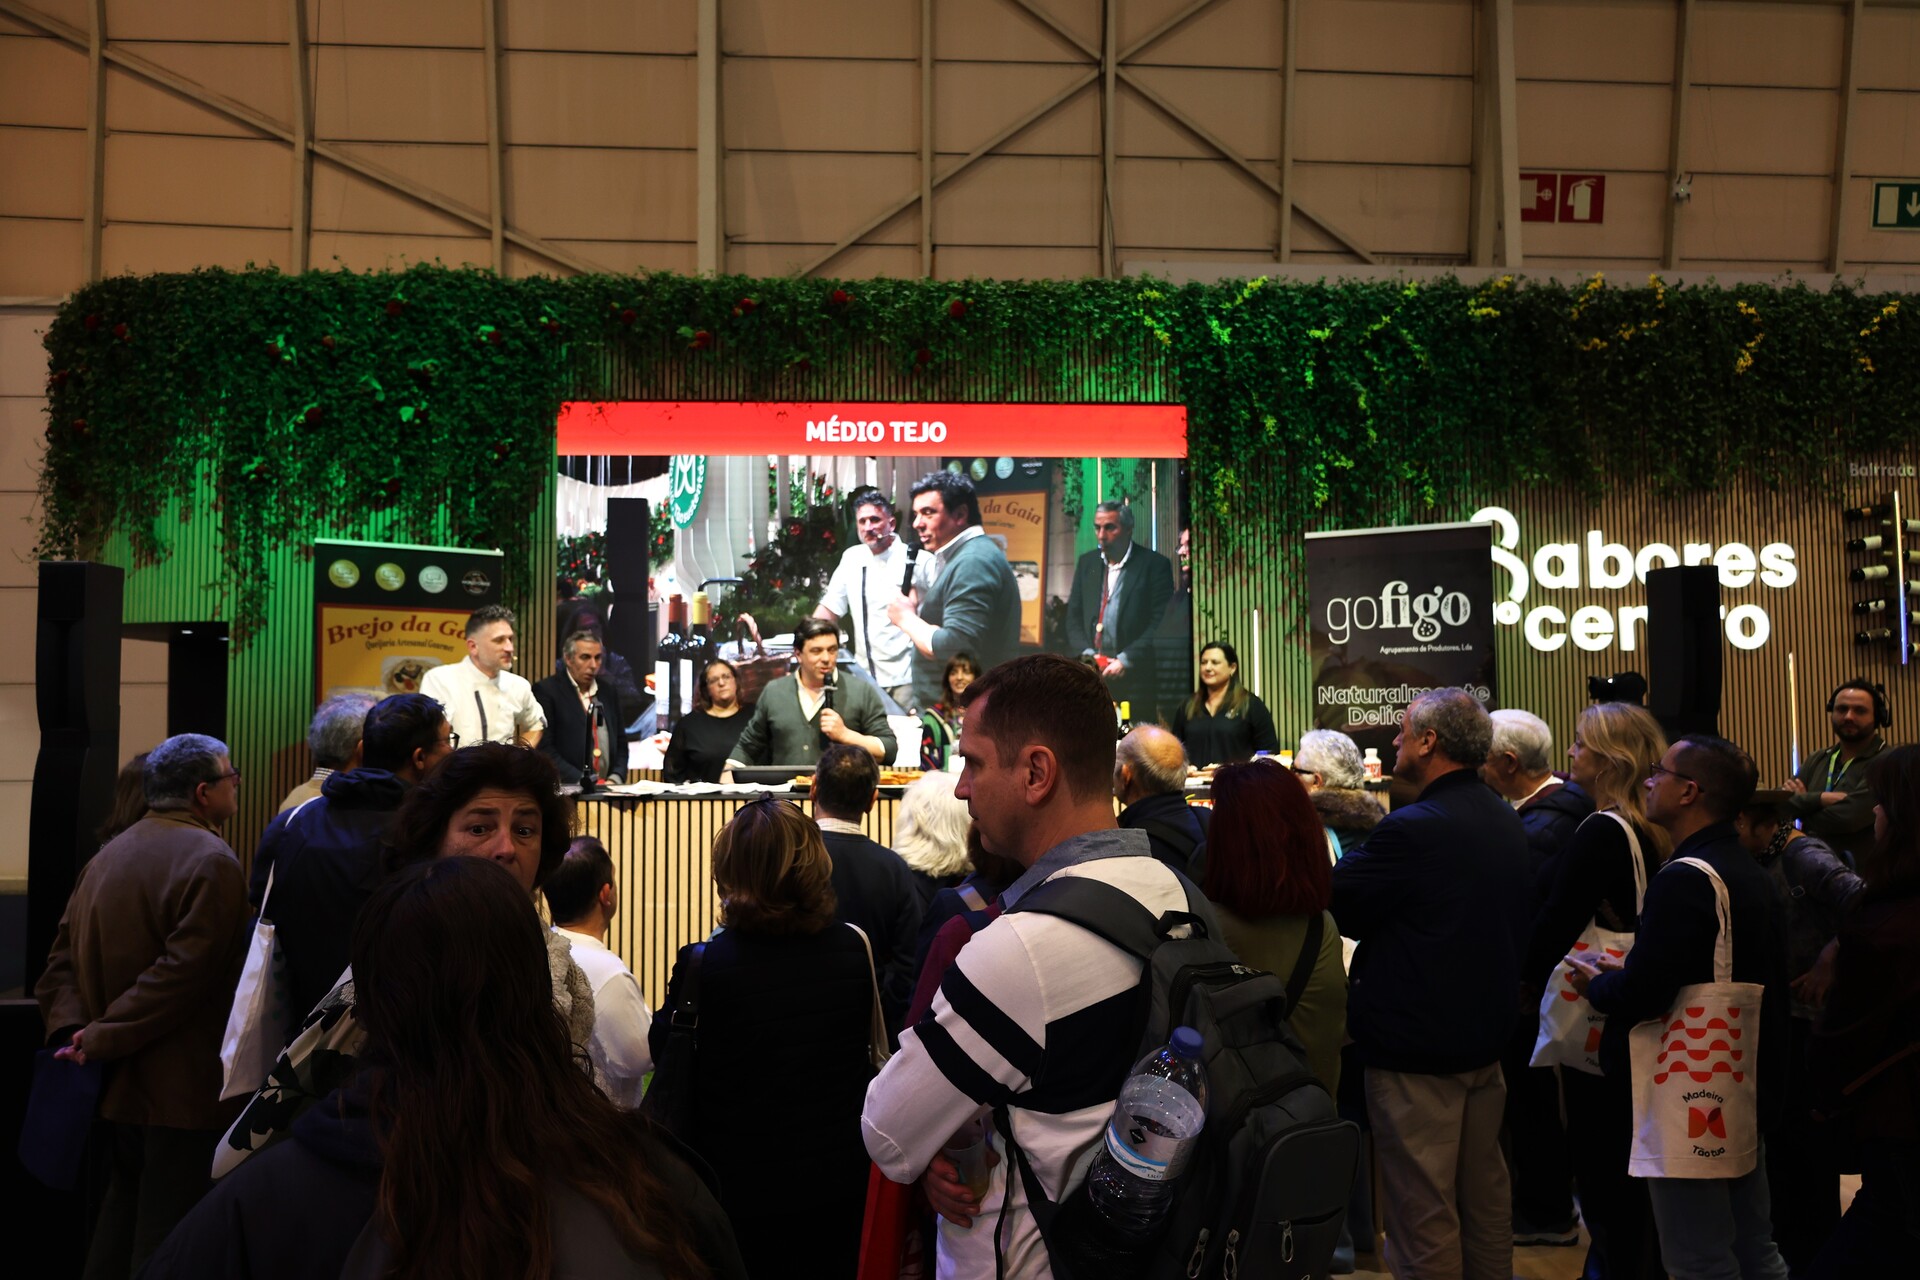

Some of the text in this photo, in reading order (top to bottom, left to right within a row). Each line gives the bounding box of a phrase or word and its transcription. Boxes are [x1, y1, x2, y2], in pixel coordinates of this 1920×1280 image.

[806, 414, 947, 443] MÉDIO TEJO
[983, 499, 1001, 514] da
[1006, 500, 1042, 525] Gaia
[1326, 580, 1471, 645] gofigo
[327, 615, 468, 646] Brejo da Ga
[1524, 604, 1770, 651] ceno
[1380, 645, 1419, 655] Agrupamento
[1318, 682, 1490, 705] Naturalte
[1348, 703, 1407, 726] Delic
[1682, 1089, 1724, 1104] Madeira
[1692, 1144, 1726, 1158] Tão tua
